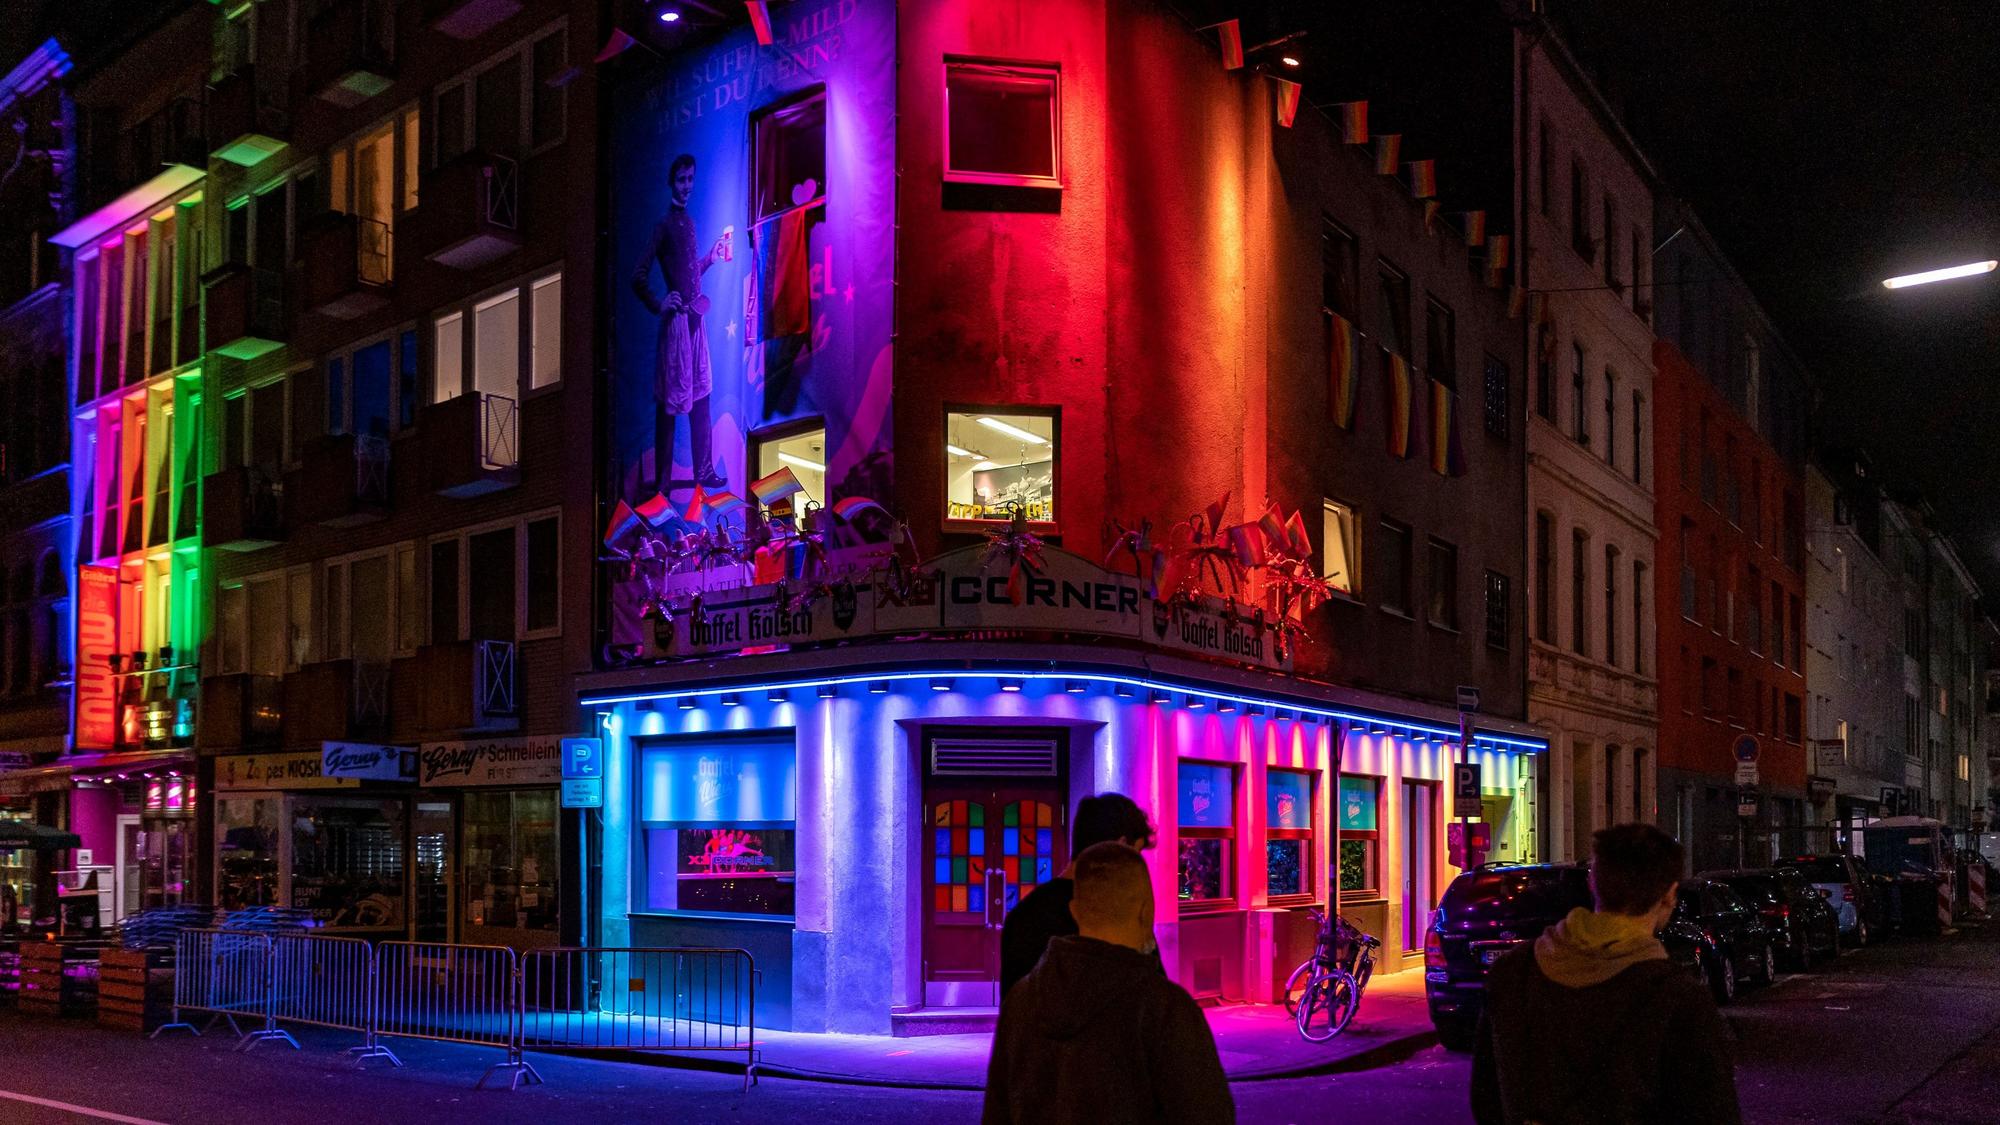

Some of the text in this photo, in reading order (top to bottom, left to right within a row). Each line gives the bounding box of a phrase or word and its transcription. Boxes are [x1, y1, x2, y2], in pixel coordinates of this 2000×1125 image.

[714, 72, 750, 111] DU
[952, 575, 1139, 614] CORNER
[572, 744, 592, 772] P
[1459, 767, 1473, 796] P
